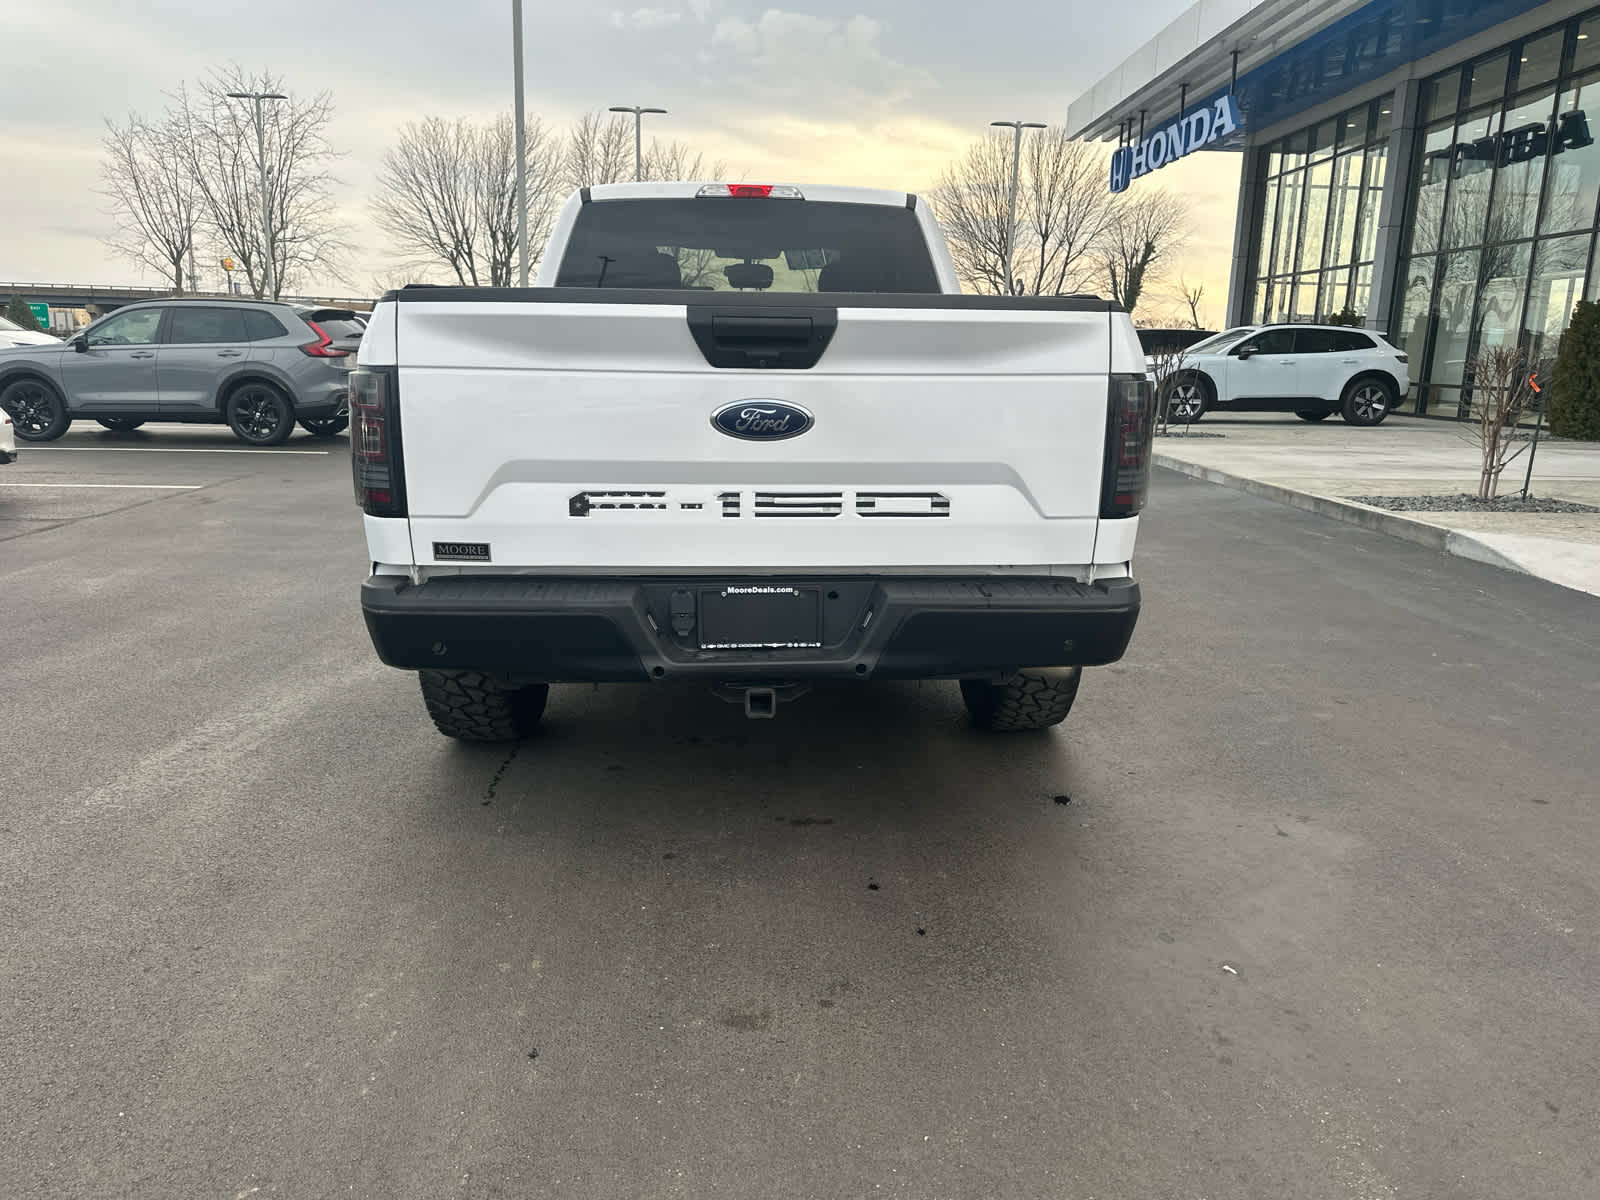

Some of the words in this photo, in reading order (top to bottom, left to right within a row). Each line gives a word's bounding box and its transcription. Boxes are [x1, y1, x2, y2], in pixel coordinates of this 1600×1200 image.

[1129, 95, 1236, 179] HONDA
[736, 408, 790, 431] Ford
[568, 491, 950, 518] F-150
[438, 544, 486, 555] MOORE
[727, 586, 793, 594] MooreDeals.com
